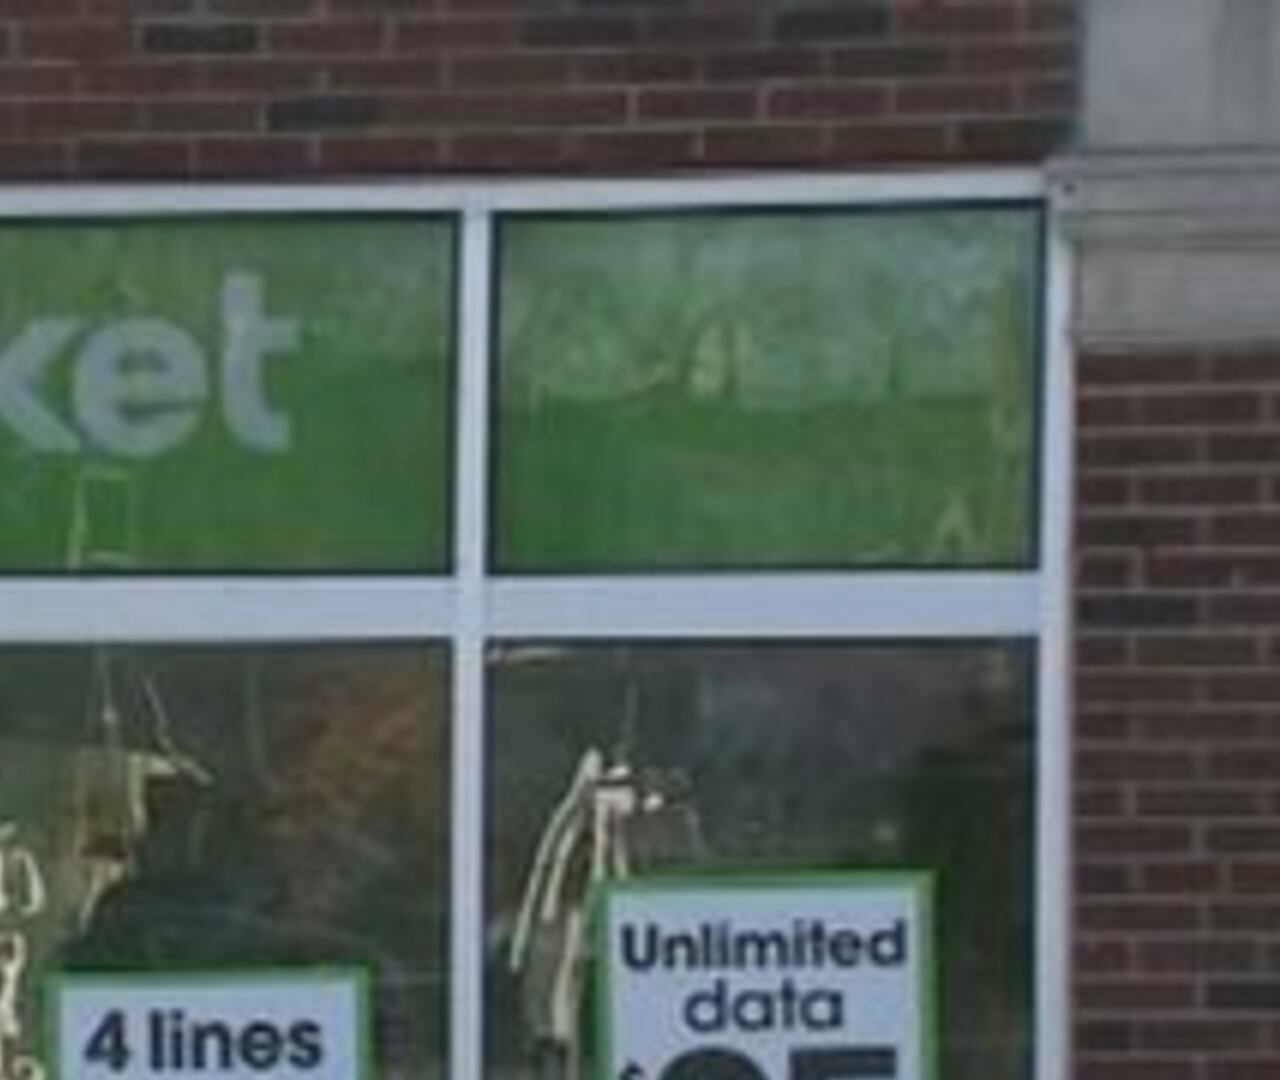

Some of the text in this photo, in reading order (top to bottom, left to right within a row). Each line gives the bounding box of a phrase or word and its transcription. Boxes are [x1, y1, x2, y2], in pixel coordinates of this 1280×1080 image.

[619, 918, 909, 974] Unlimited
[682, 978, 845, 1034] data
[83, 1007, 324, 1073] 4 lines
